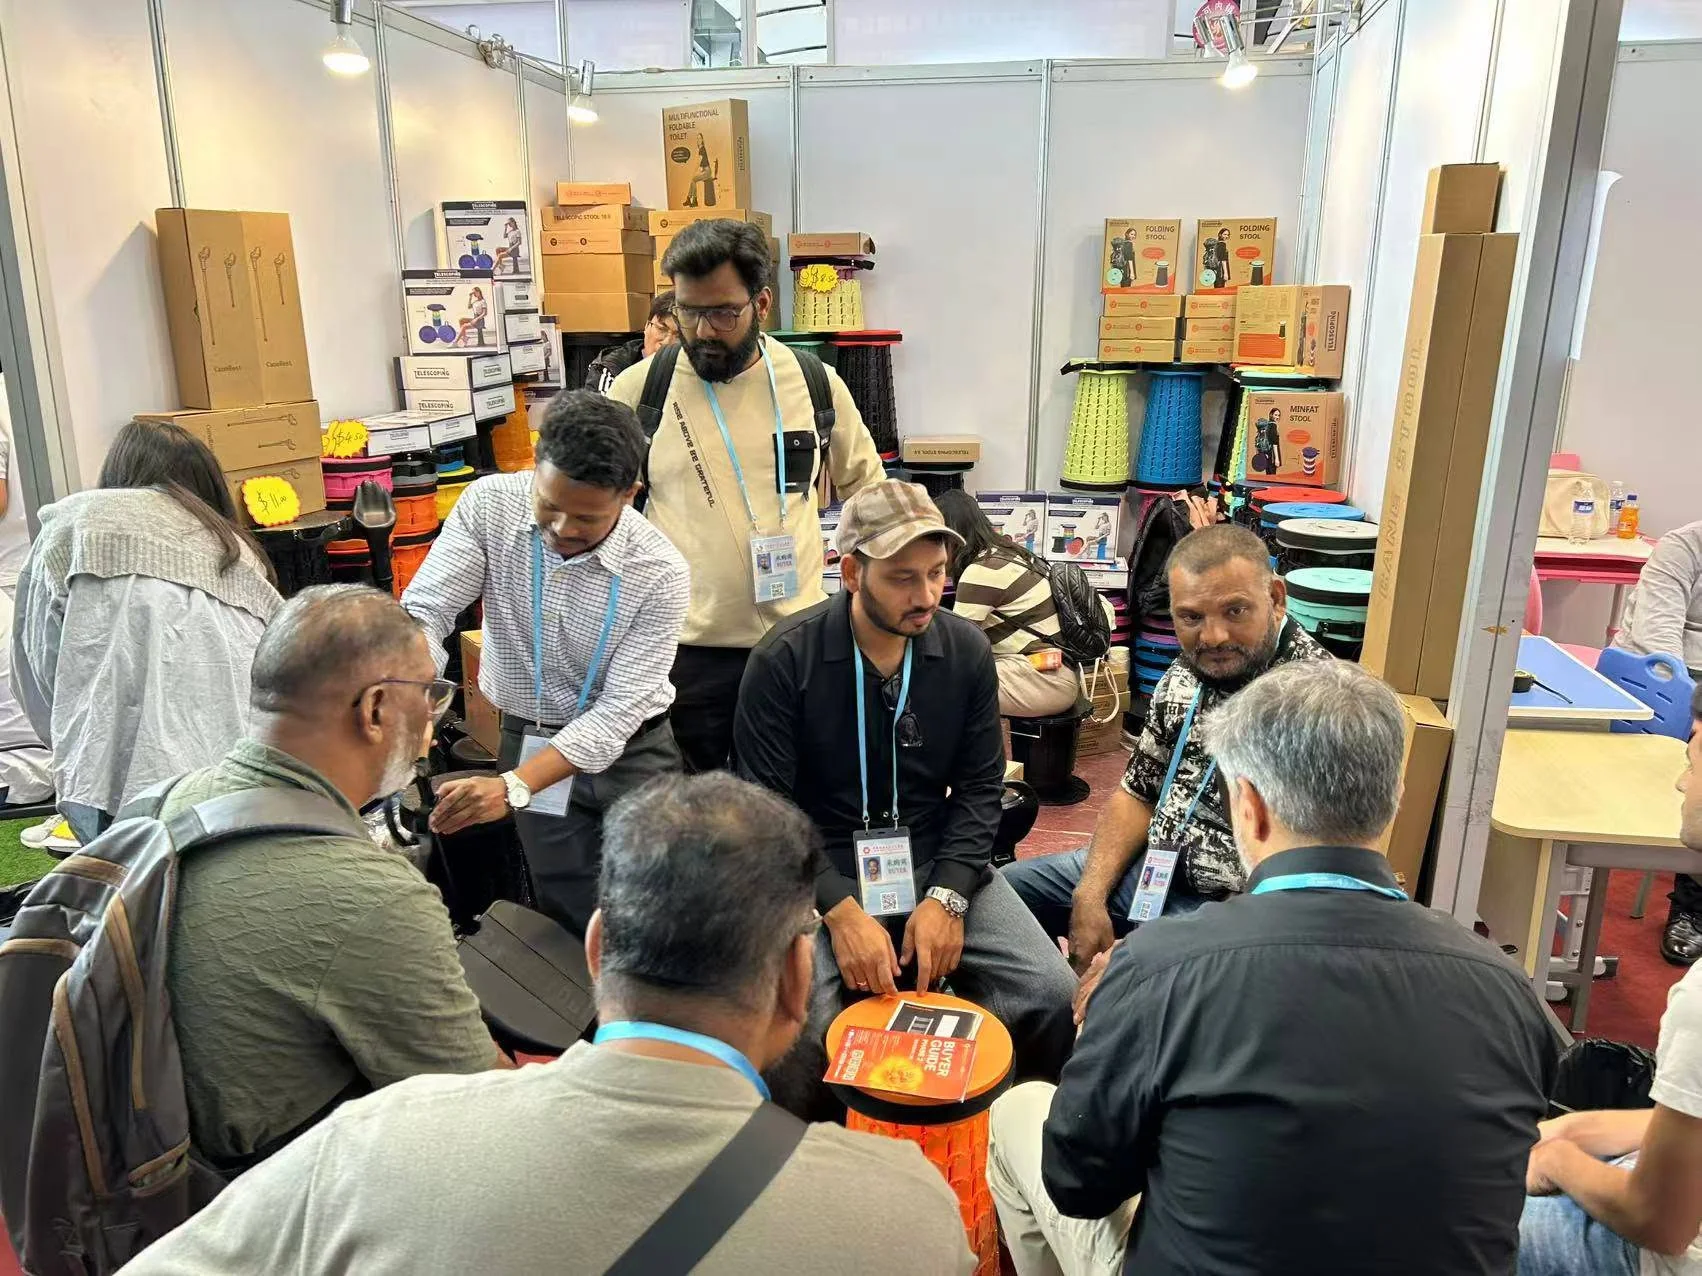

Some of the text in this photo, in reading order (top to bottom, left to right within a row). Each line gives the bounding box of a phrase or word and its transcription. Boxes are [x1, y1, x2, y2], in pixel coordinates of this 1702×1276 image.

[668, 109, 720, 121] MULTIFUNCTIONAL
[668, 121, 696, 131] FOLDABLE
[669, 132, 687, 141] TOILET
[1145, 225, 1175, 233] FOLDING
[1327, 311, 1338, 352] TELESCOPING
[413, 370, 450, 378] TELESCOPING
[418, 402, 454, 411] TELESCOPING
[1289, 405, 1320, 414] MINFAT
[1289, 415, 1312, 423] STOOL
[924, 1039, 940, 1072] GUIDE
[936, 1040, 956, 1078] BUYER
